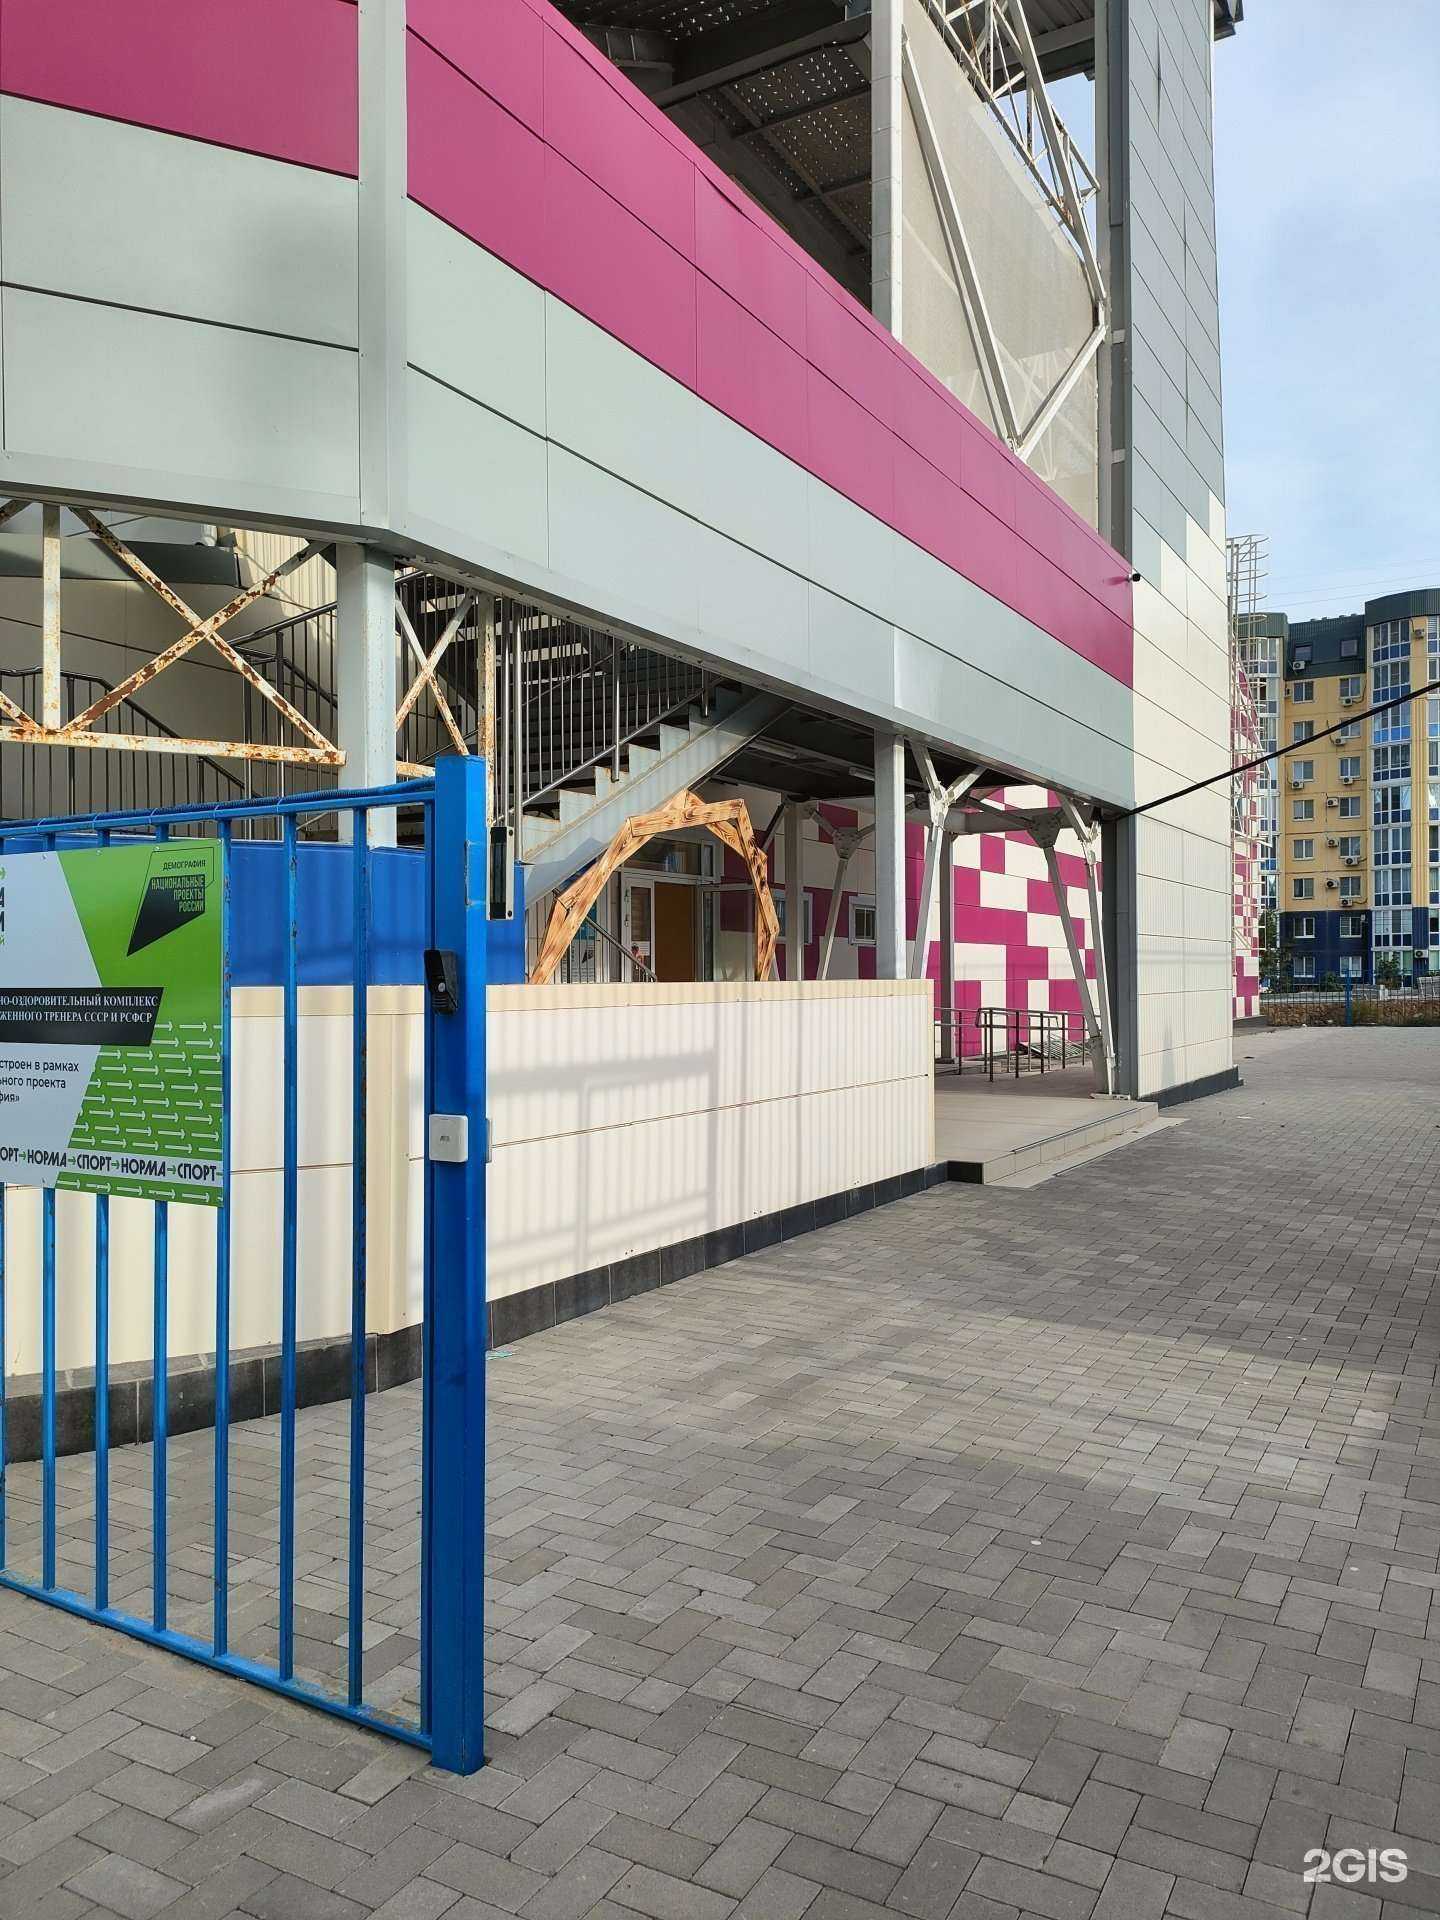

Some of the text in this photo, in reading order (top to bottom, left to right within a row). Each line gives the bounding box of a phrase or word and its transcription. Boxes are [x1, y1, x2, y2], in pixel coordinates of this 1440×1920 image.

[162, 859, 206, 871] ДЕМОГРАФИЯ
[151, 875, 205, 890] НАЦИОНАЛЬНЫЕ
[173, 888, 205, 901] ПРОЕКТЫ
[178, 900, 204, 912] РОССИИ
[103, 995, 159, 1007] КОМПЛЕКС
[44, 1011, 82, 1022] ТРЕНЕРА
[84, 1011, 109, 1022] СССР
[110, 1012, 118, 1022] И
[120, 1012, 152, 1023] РСФСР
[34, 1061, 40, 1070] в
[42, 1061, 80, 1073] рамках
[0, 1077, 66, 1090] ного проекта
[27, 1149, 67, 1167] НОРМА
[76, 1154, 112, 1171] СПОРТ
[121, 1157, 166, 1176] НОРМА
[177, 1163, 217, 1181] СПОРТ
